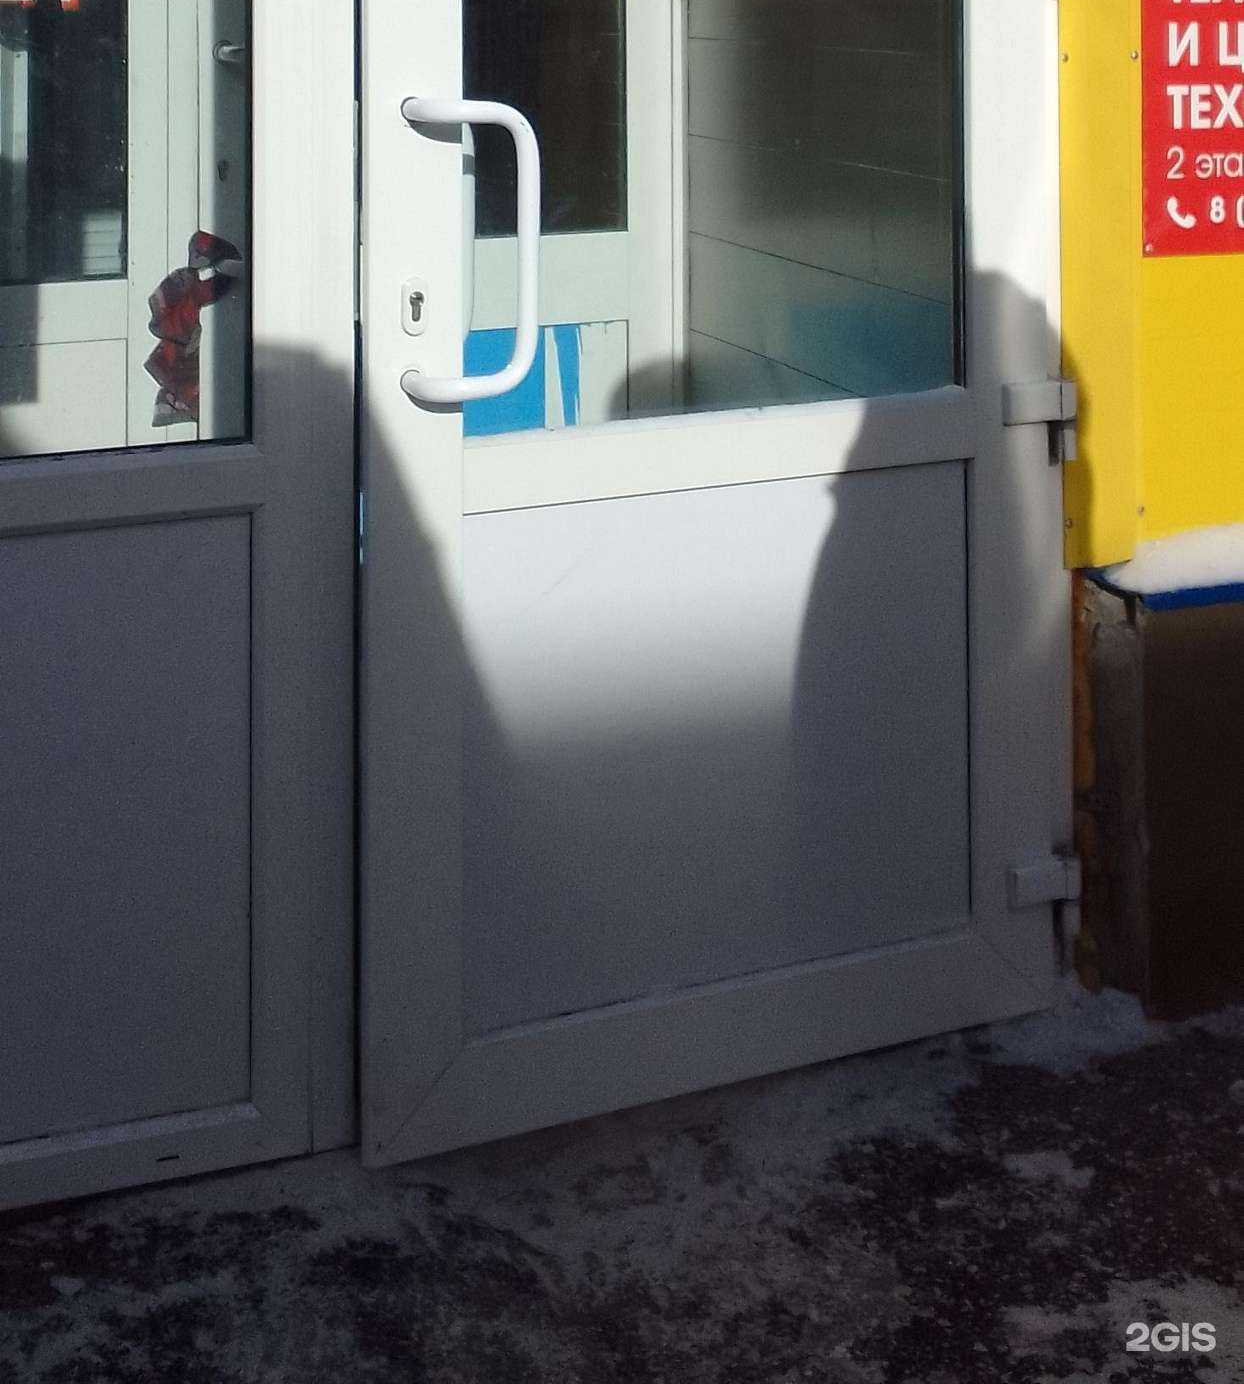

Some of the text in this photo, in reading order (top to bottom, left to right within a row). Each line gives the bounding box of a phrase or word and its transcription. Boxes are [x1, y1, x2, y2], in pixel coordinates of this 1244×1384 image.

[1168, 19, 1199, 67] И
[1166, 83, 1244, 130] ТЕХ
[1166, 145, 1244, 180] 2 эта
[1209, 194, 1226, 224] 8
